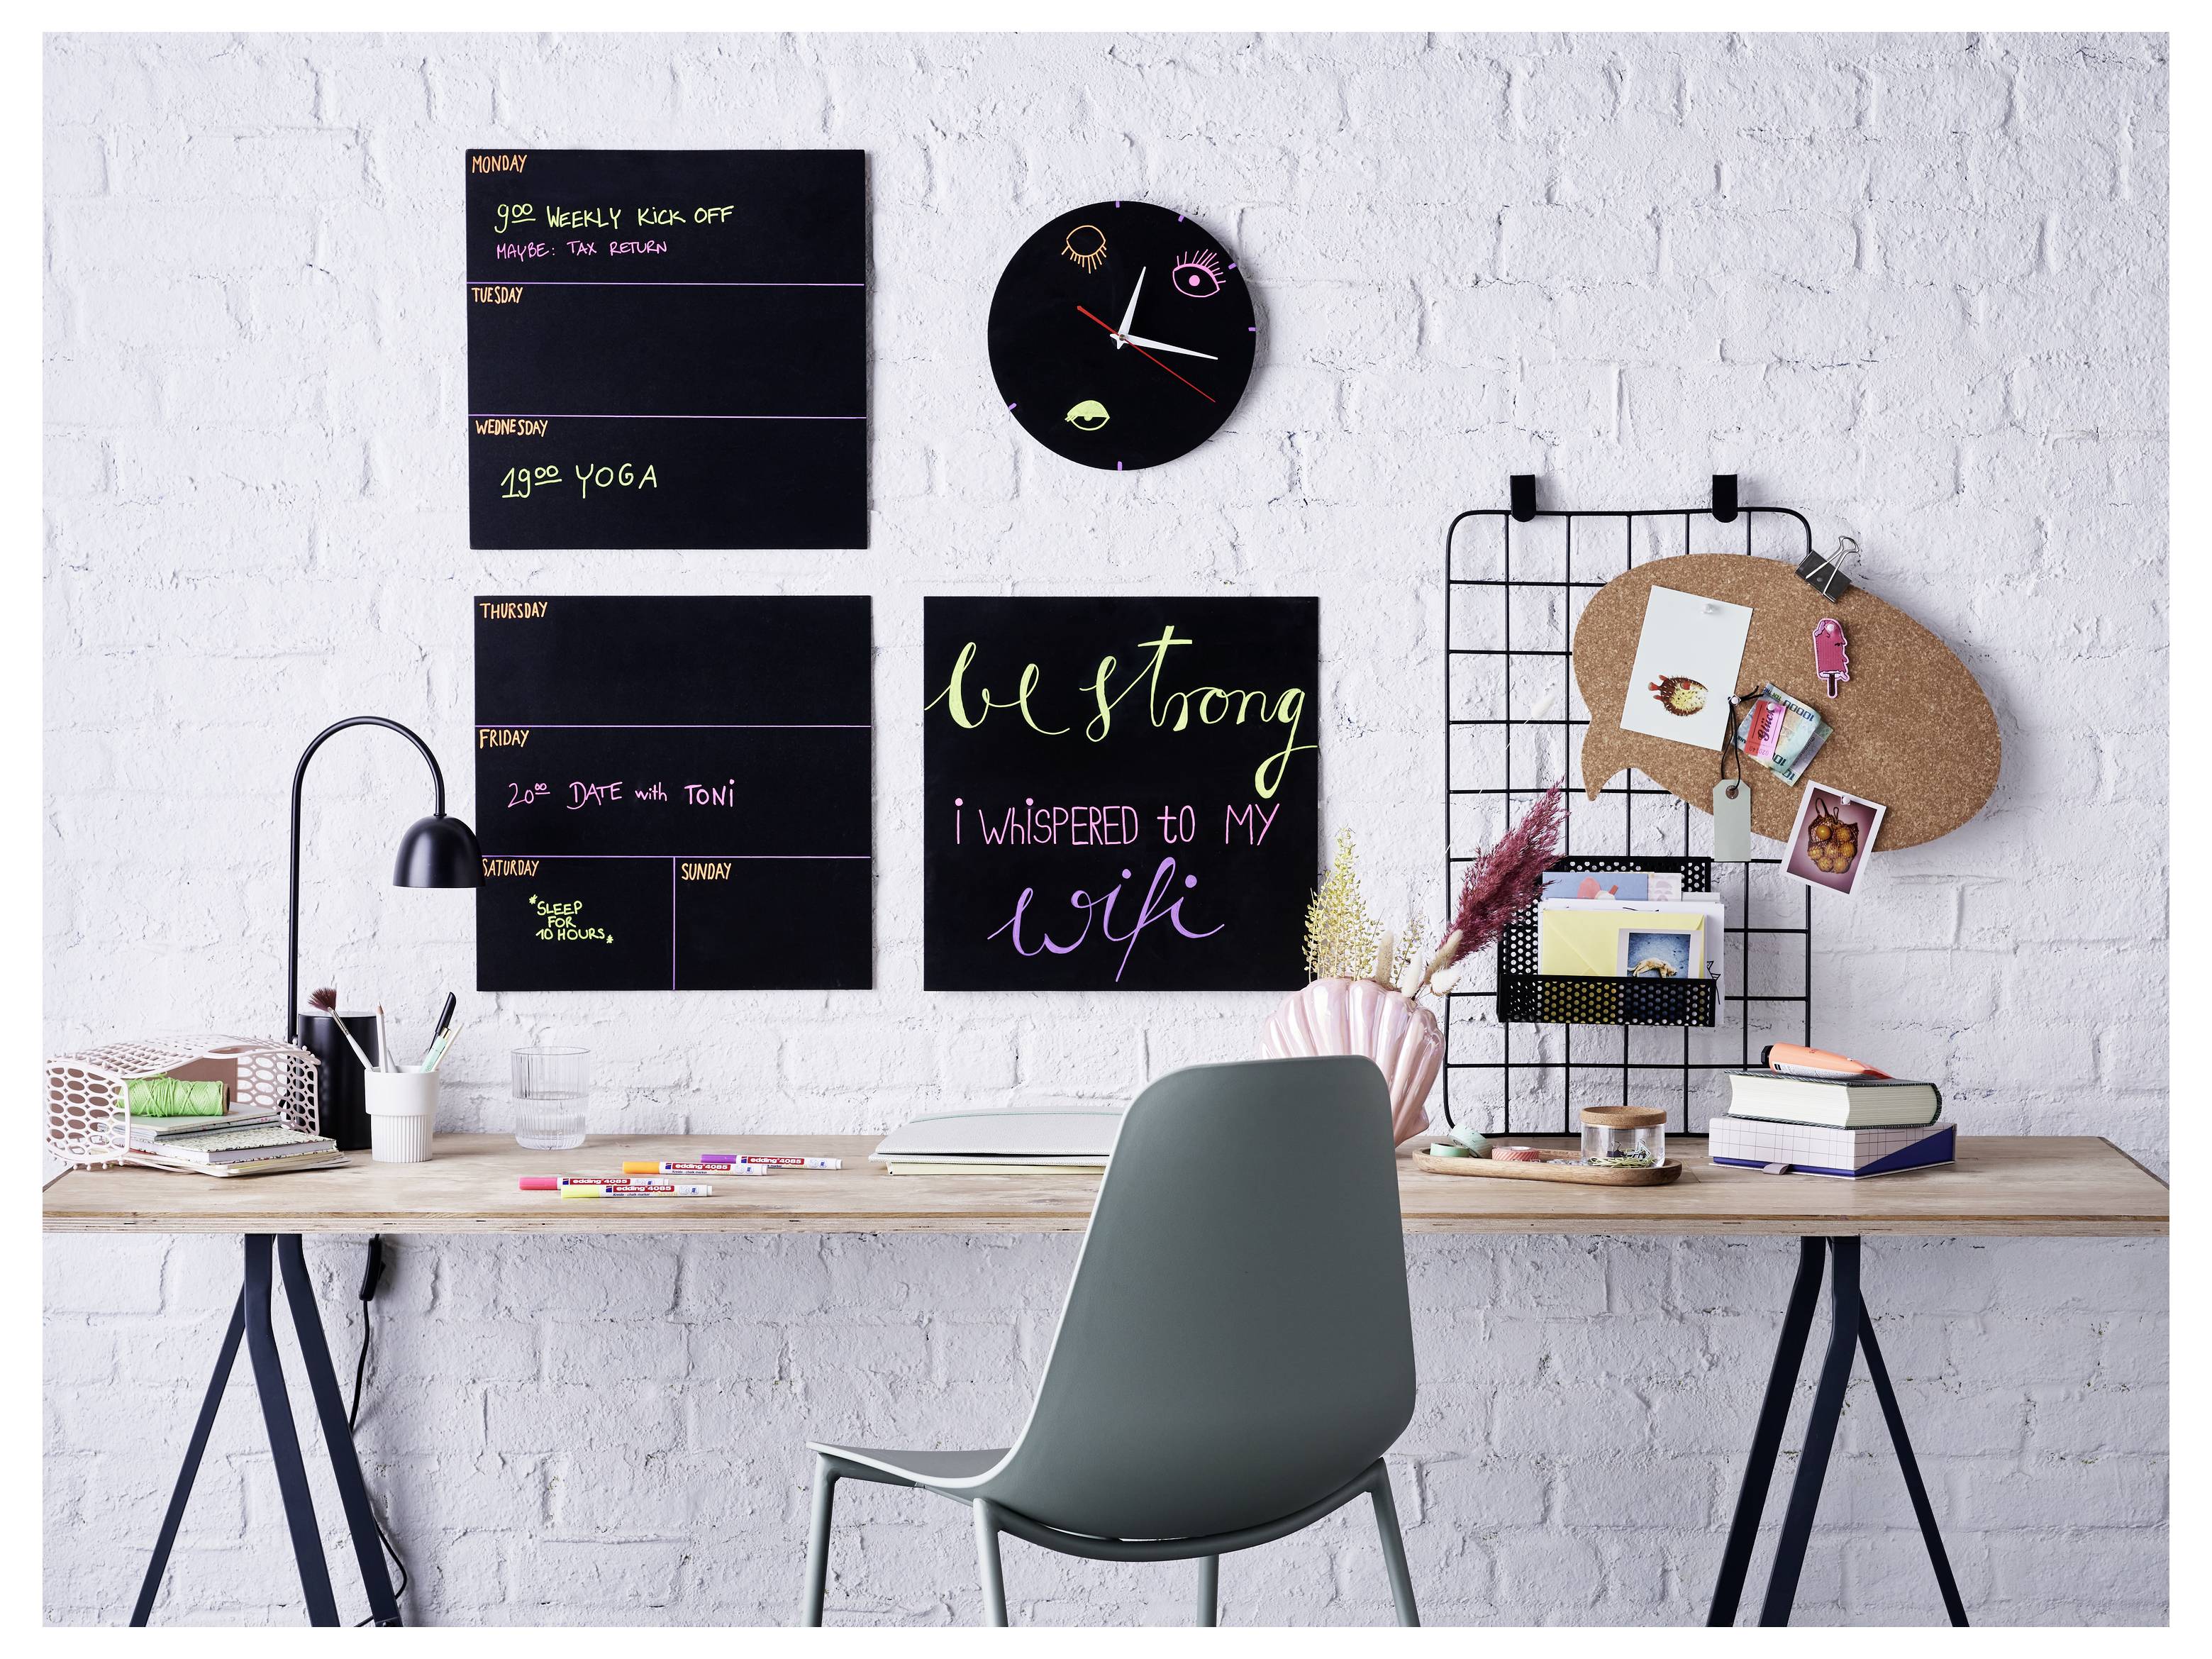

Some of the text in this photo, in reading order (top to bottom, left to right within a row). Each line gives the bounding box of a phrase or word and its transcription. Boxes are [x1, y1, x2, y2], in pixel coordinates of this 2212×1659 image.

[472, 154, 528, 174] MONDAY
[546, 206, 621, 229] WEEKLY
[694, 205, 735, 224] OFF
[496, 240, 667, 262] MAYBE: TAX RETURN
[471, 287, 523, 304] TUESDAY
[475, 418, 548, 438] WEDNESDAY
[575, 462, 657, 499] YOGA
[479, 601, 548, 620] THURSDAY
[923, 625, 1318, 799] be strong
[479, 728, 530, 749] FRIDAY
[566, 781, 623, 810] DATE
[634, 781, 667, 802] with
[1225, 803, 1280, 846] MY
[482, 858, 540, 877] SATURDAY
[681, 862, 732, 881] SUNDAY
[548, 915, 577, 928] FOR
[986, 856, 1225, 982] wifi
[535, 928, 553, 941] 10
